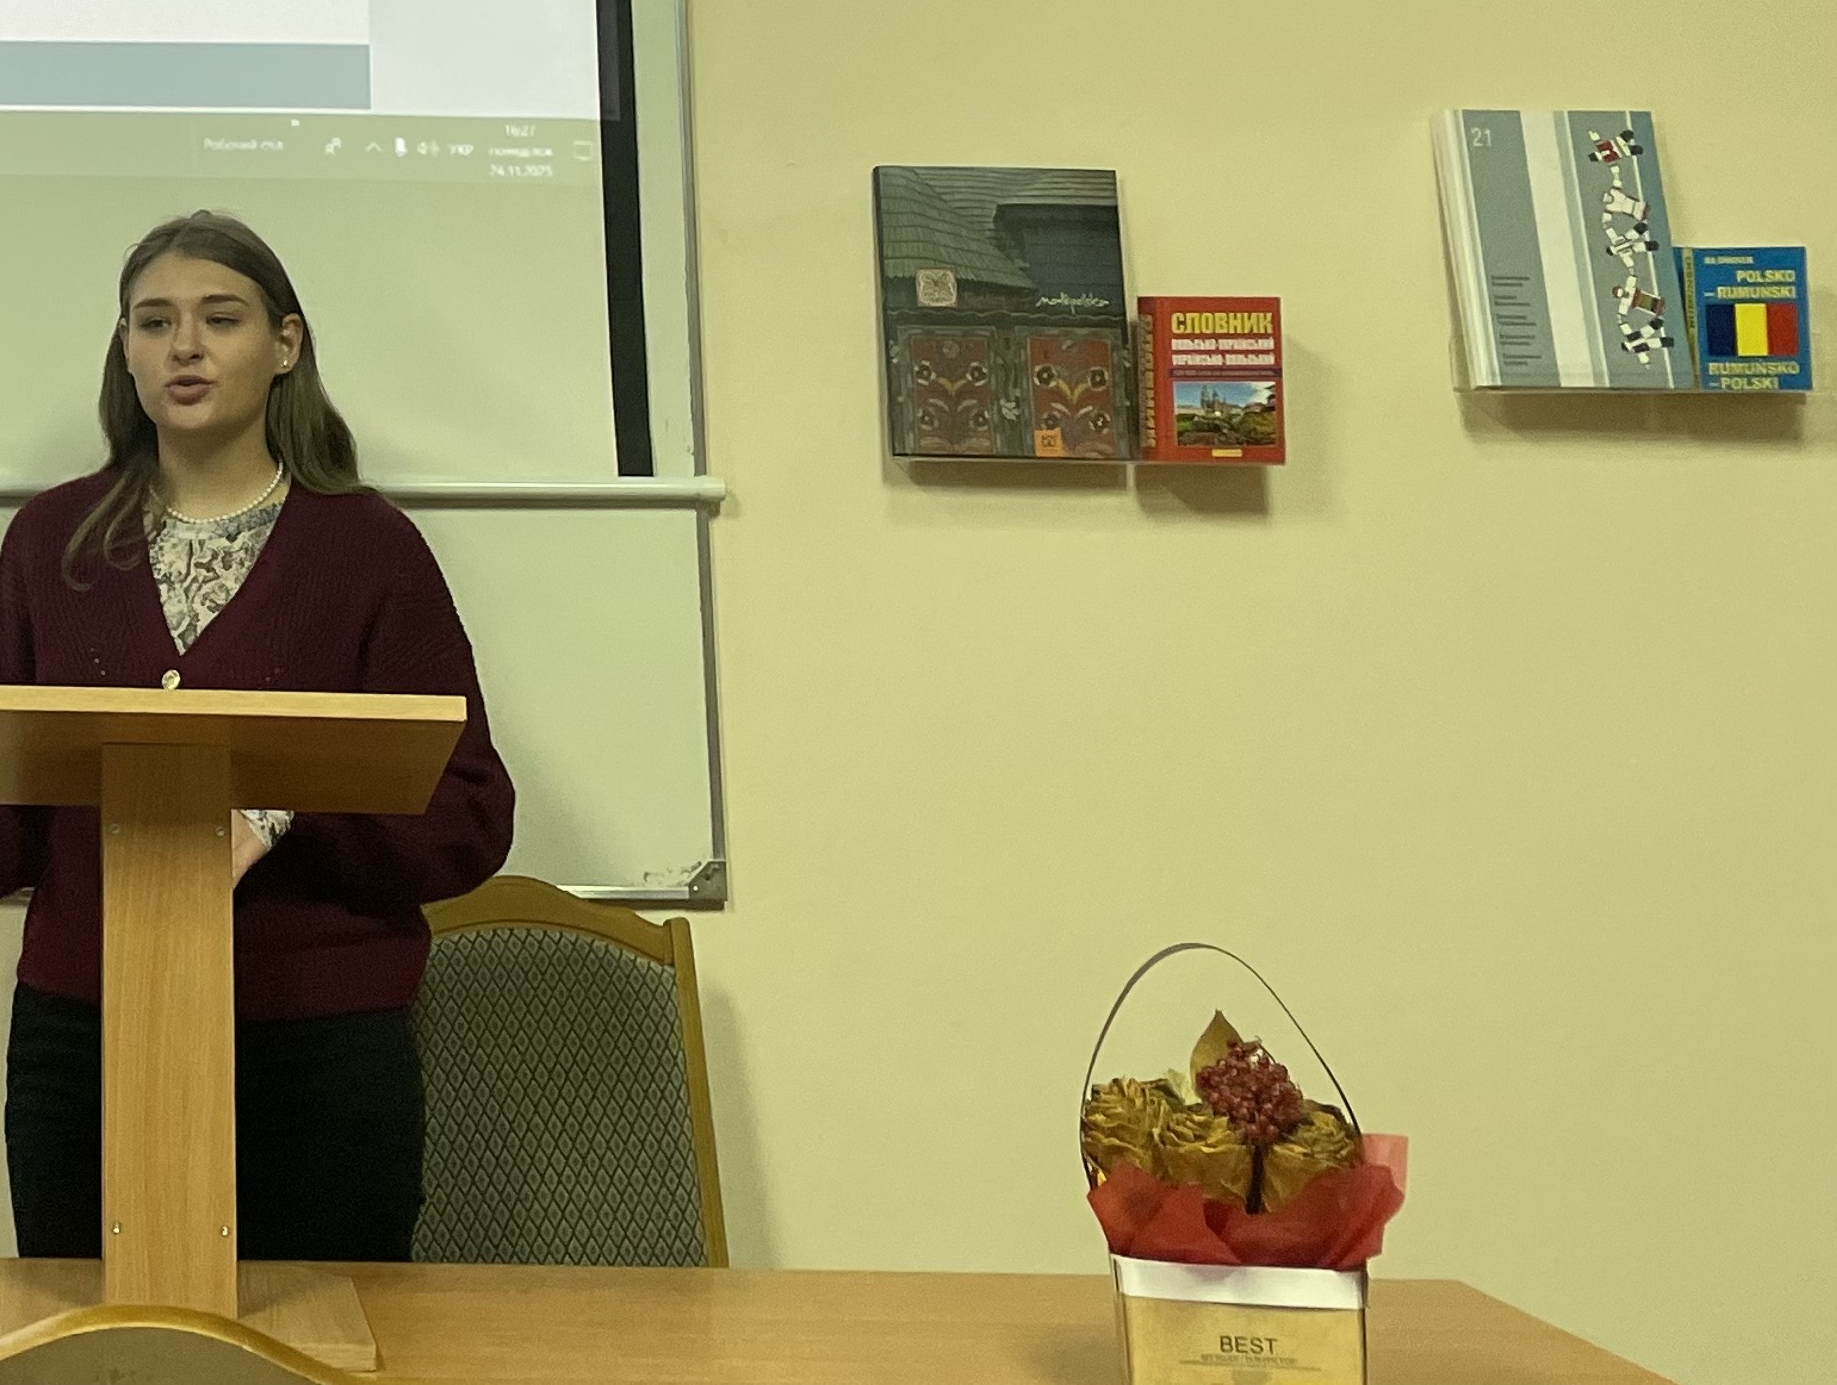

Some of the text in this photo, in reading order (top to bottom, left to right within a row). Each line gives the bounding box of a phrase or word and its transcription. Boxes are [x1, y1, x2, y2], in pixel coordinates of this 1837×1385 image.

[1470, 127, 1493, 148] 21
[1736, 269, 1796, 284] POLSKO
[1171, 312, 1274, 334] СЛОВНИК
[1720, 376, 1780, 390] POLSKI
[1219, 1334, 1278, 1354] BEST
